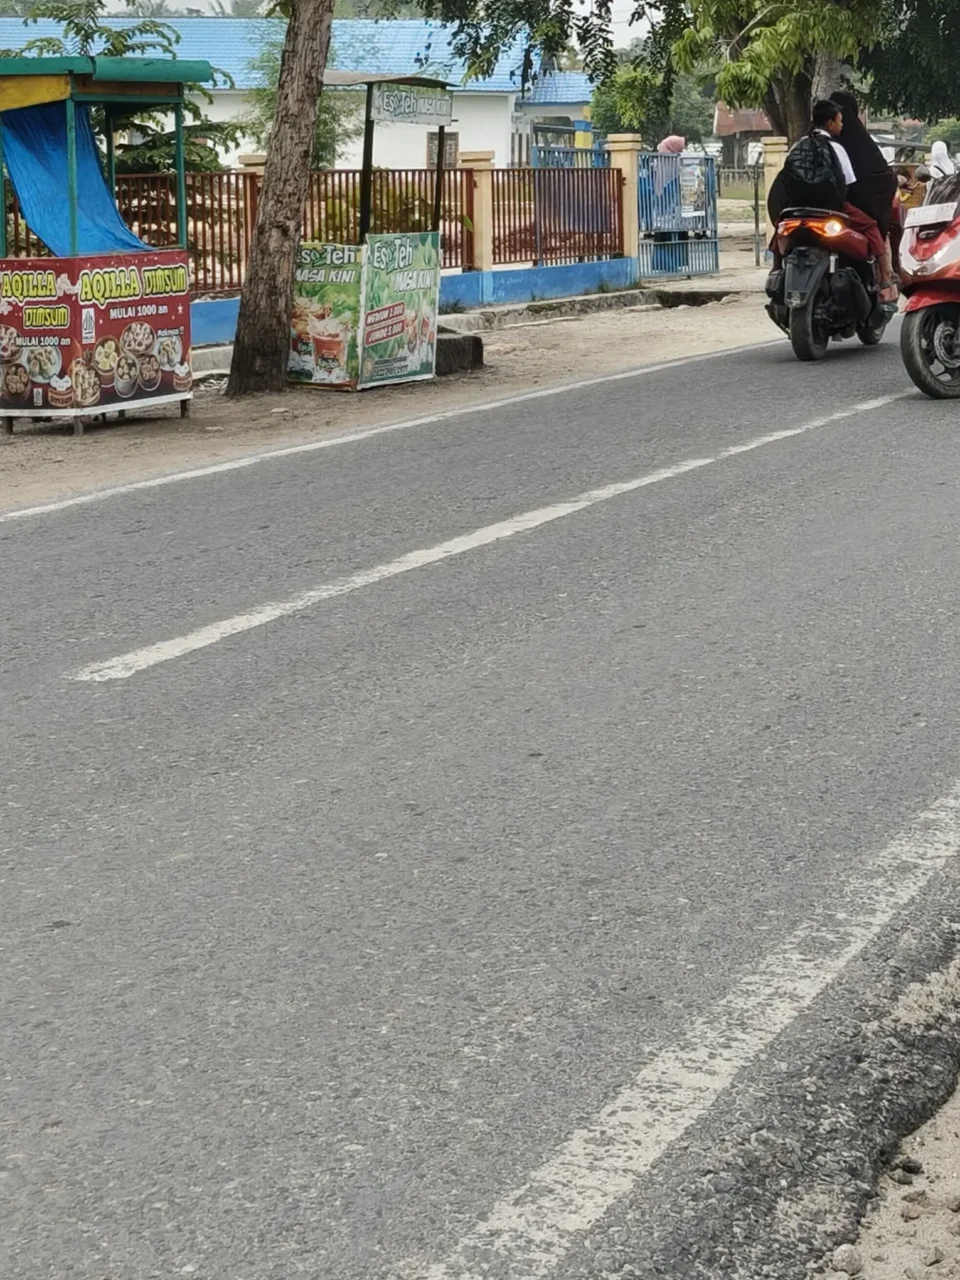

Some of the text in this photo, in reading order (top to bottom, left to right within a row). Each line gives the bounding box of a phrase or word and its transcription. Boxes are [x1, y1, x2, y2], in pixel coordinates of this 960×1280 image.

[322, 244, 356, 265] Teh
[373, 237, 413, 269] Es Teh
[79, 264, 187, 307] AQILLA DIMSUM
[328, 270, 357, 283] KINI
[1, 271, 58, 304] AQILLA
[24, 306, 69, 328] DIMSUM
[109, 304, 168, 320] MULAI 1000 an
[15, 336, 39, 347] MULAI
[40, 336, 60, 346] 1000
